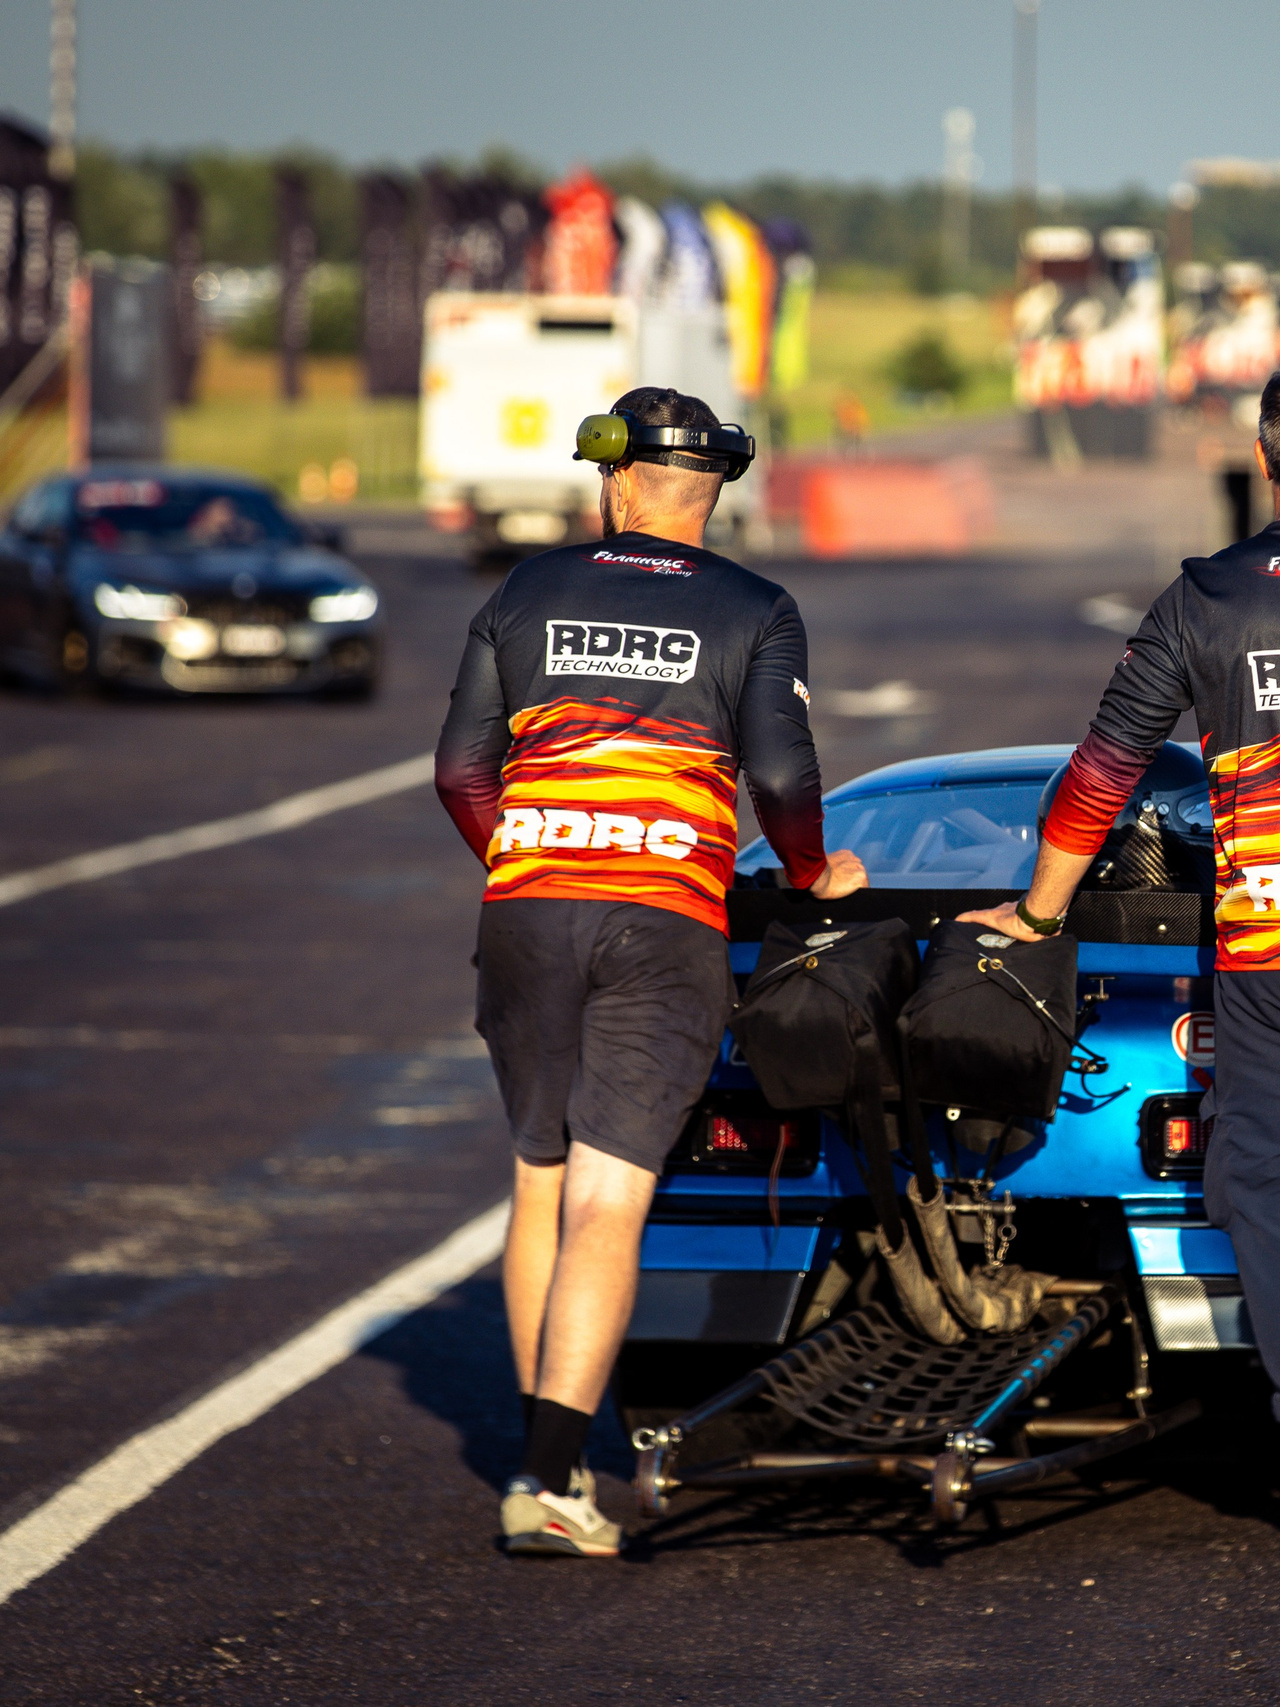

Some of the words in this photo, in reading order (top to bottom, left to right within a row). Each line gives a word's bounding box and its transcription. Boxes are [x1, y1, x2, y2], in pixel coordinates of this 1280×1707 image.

[593, 551, 685, 568] FLAMHOLC
[551, 624, 696, 664] RDRC
[551, 659, 689, 680] TECHNOLOGY
[500, 807, 699, 860] RDRC
[1192, 1021, 1215, 1053] E
